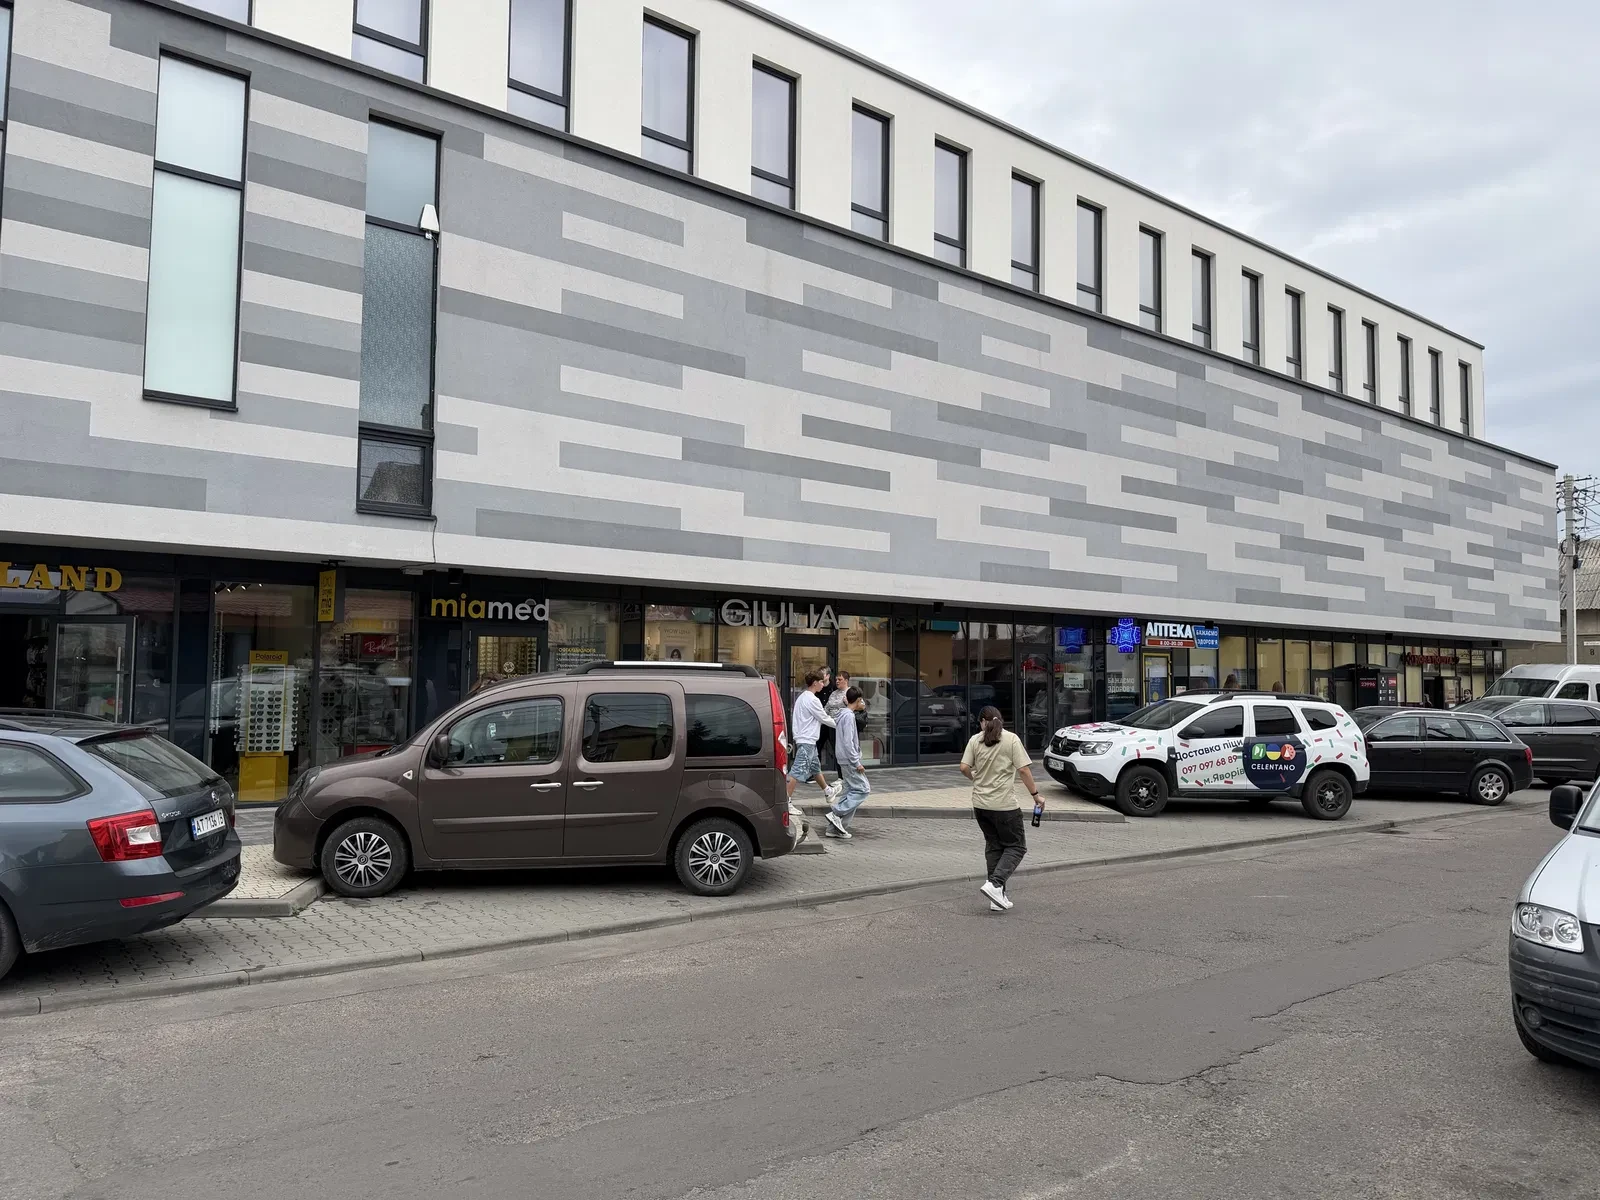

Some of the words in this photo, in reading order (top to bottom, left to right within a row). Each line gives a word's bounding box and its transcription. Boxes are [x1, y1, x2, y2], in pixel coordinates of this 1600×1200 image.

[0, 561, 122, 592] LAND
[430, 592, 550, 621] miamed
[721, 598, 839, 630] GIULIA
[1145, 621, 1194, 639] АПТЕКА
[1175, 745, 1221, 762] Доставка
[1182, 764, 1197, 775] 097
[1199, 761, 1214, 771] 097
[1216, 757, 1226, 767] 68
[1227, 754, 1238, 765] 89
[1250, 763, 1296, 771] CELENTANO
